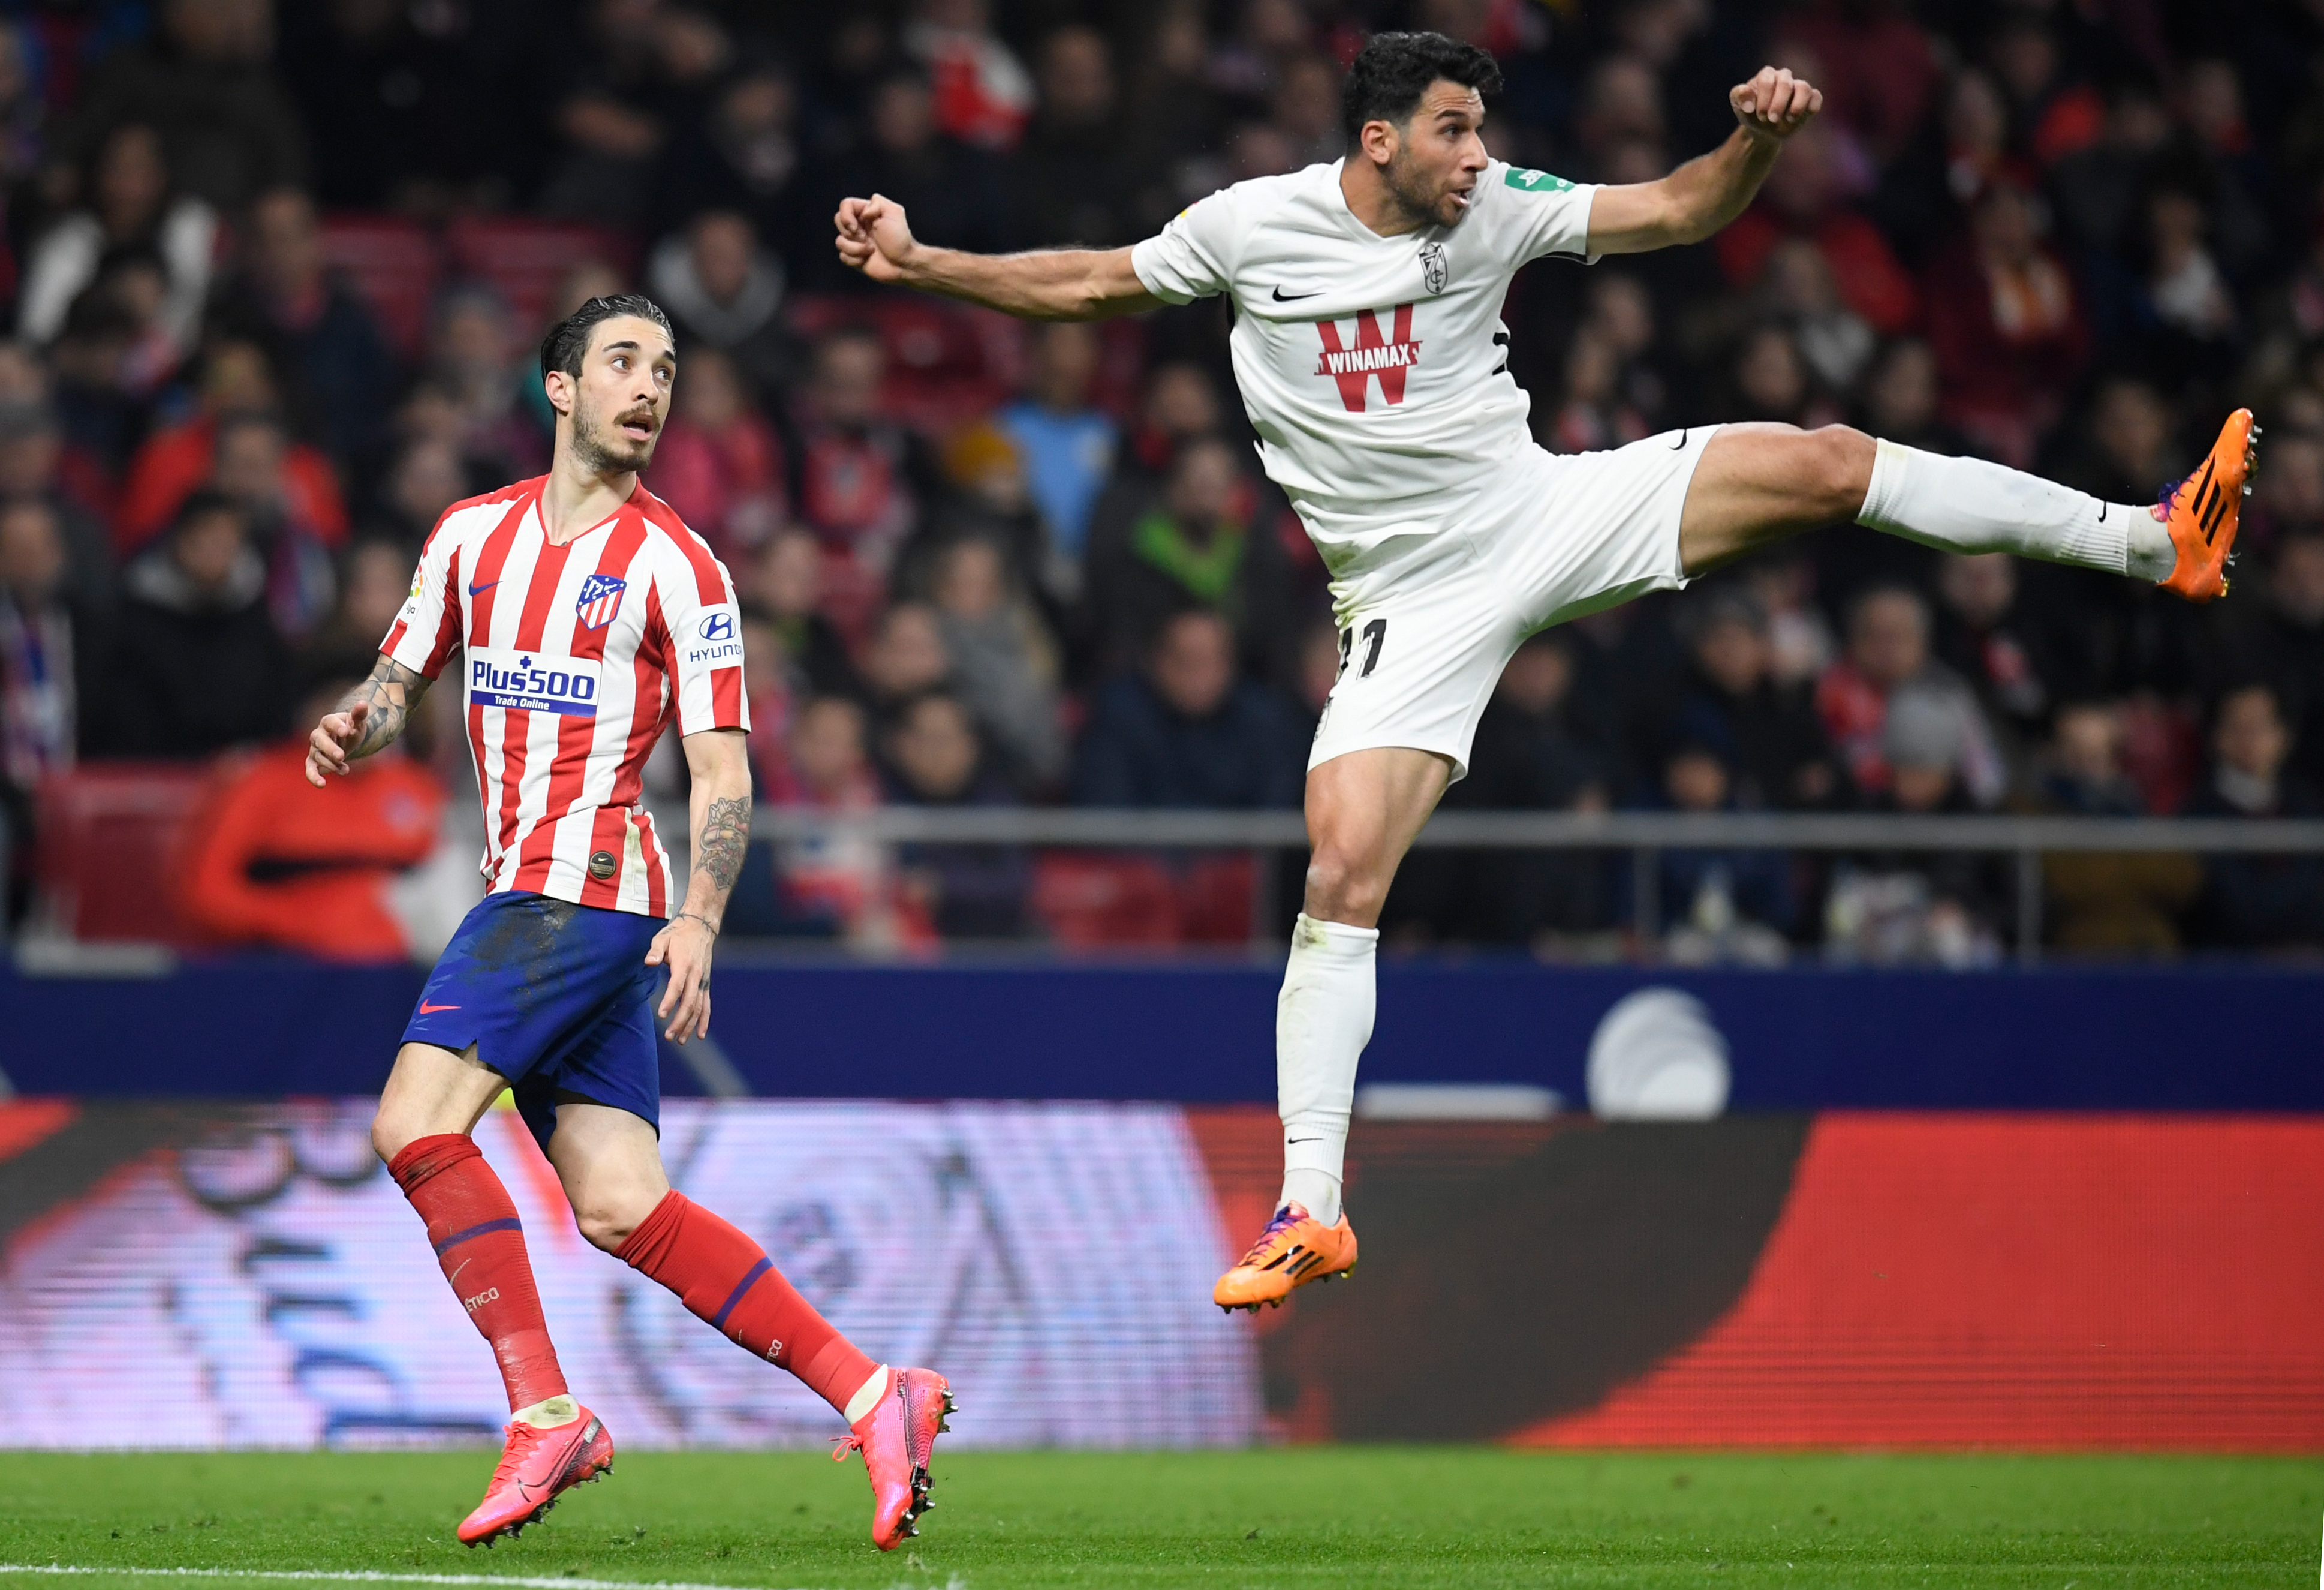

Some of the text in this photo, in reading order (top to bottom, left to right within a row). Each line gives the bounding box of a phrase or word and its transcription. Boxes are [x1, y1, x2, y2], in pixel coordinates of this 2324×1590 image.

[1326, 343, 1411, 374] WINAMAX
[472, 660, 595, 701] Plus500
[495, 695, 550, 710] Trade Online
